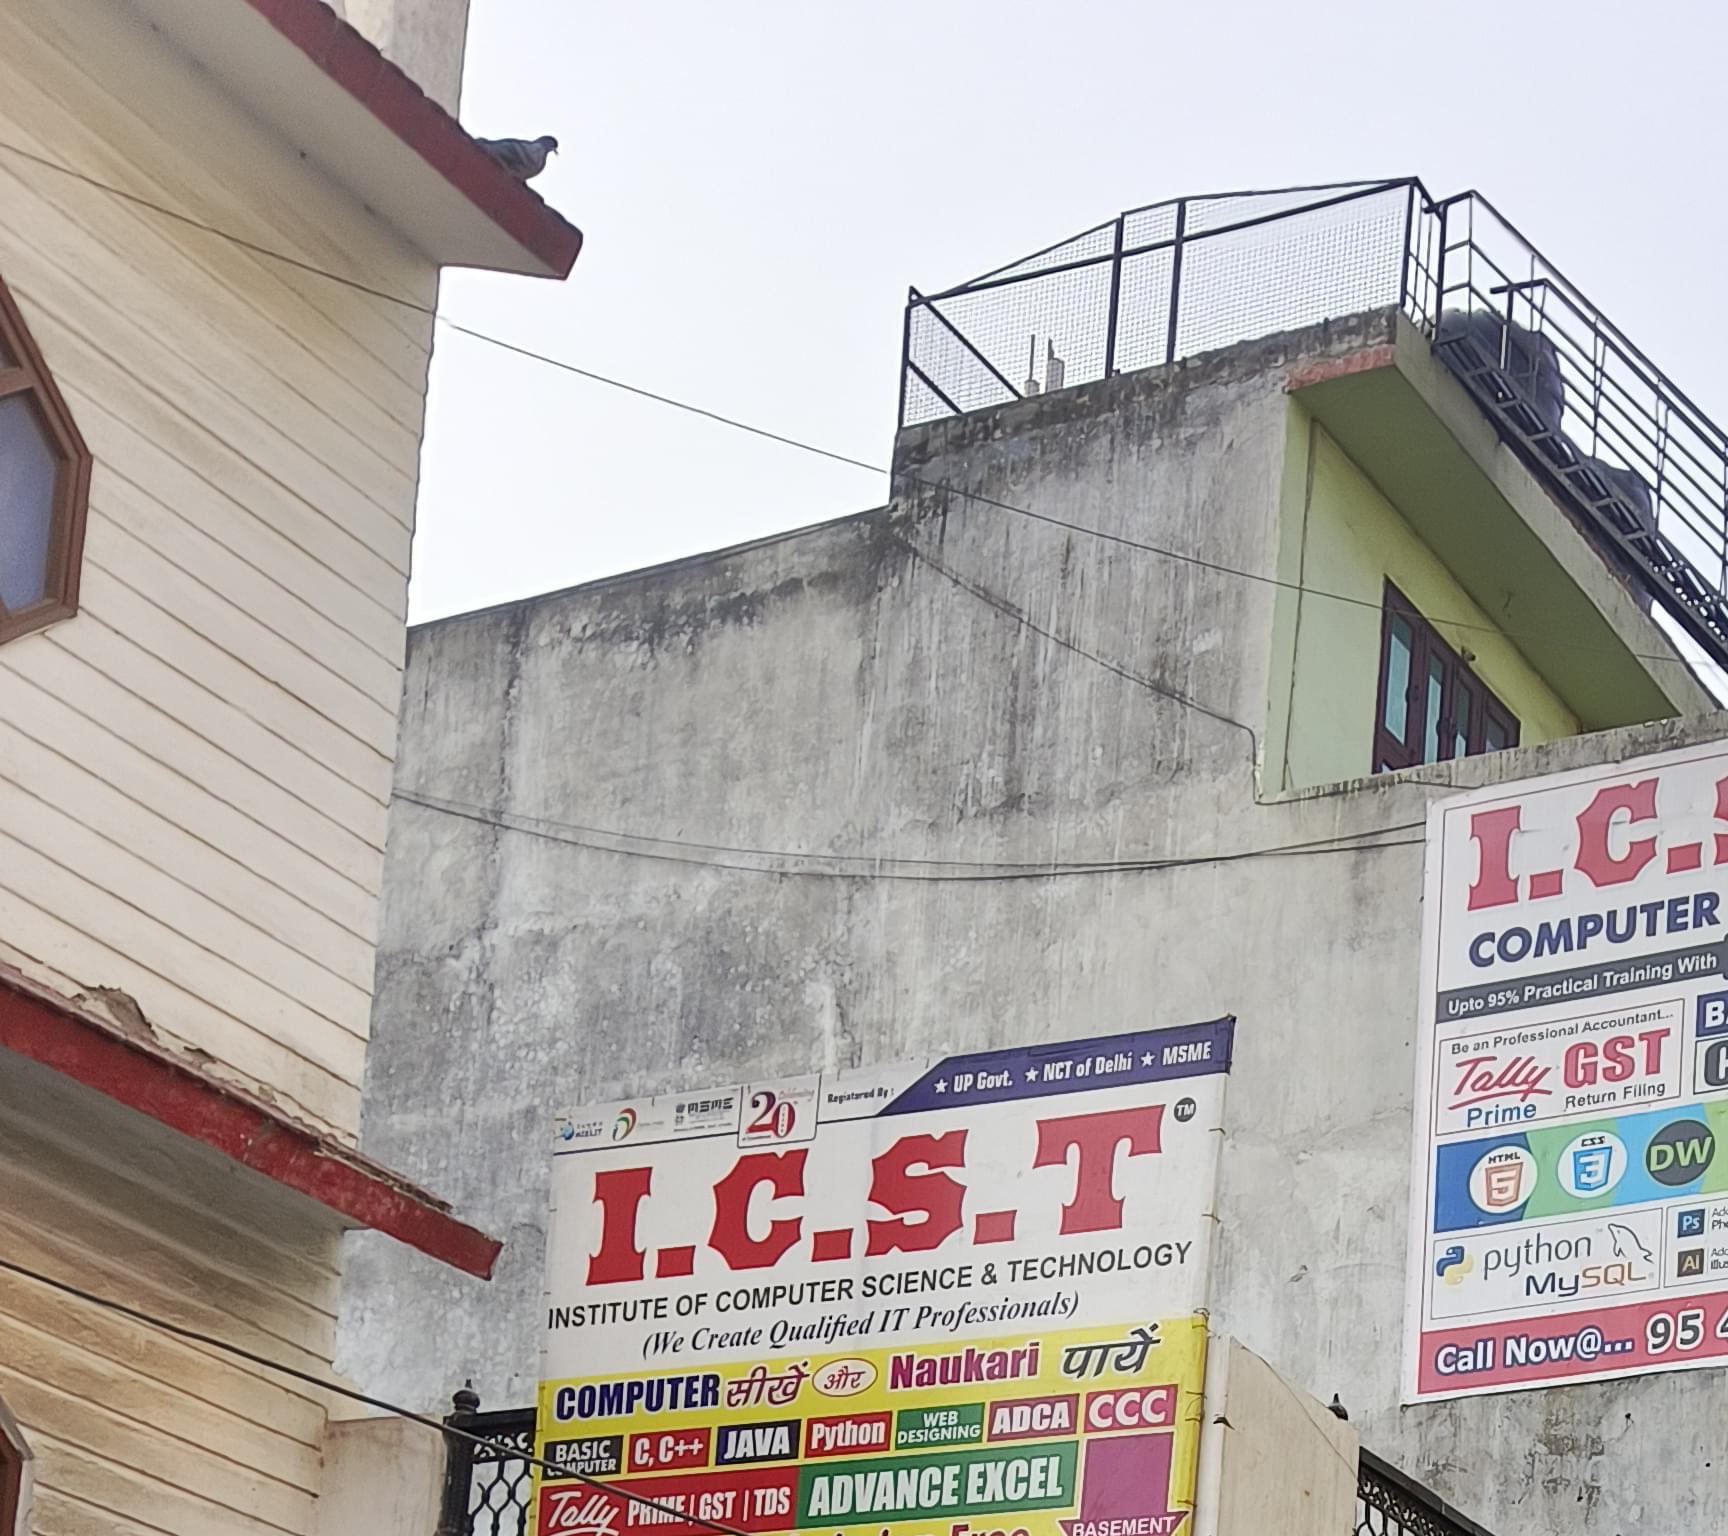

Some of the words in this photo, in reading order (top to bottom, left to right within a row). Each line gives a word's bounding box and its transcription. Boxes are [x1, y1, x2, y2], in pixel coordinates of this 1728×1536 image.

[1468, 892, 1721, 968] COMPUTER
[1448, 993, 1485, 1015] Upto
[1488, 987, 1520, 1009] 95%
[1523, 974, 1598, 1003] Practical
[1603, 960, 1674, 989] Training
[1677, 953, 1718, 974] With
[1451, 1043, 1469, 1055] Be
[1473, 1040, 1489, 1051] an
[1493, 1023, 1579, 1048] Professional
[953, 1073, 973, 1093] UP
[977, 1069, 1013, 1090] Govt.
[1043, 1061, 1073, 1082] NCT
[1076, 1057, 1093, 1077] of
[1095, 1051, 1133, 1075] Delhi
[1162, 1041, 1212, 1066] MSME
[1563, 1027, 1671, 1089] GST
[1449, 1055, 1552, 1107] Tally
[1565, 1090, 1617, 1110] Return
[1622, 1082, 1666, 1099] Filing
[745, 1090, 797, 1138] 20
[1466, 1103, 1537, 1128] Prime
[1487, 1151, 1521, 1164] HTML
[1649, 1136, 1714, 1172] DW
[1682, 1215, 1700, 1231] Ps
[1484, 1233, 1592, 1280] python
[548, 1296, 668, 1329] INSTITUTE
[675, 1293, 708, 1317] OF
[715, 1278, 854, 1312] COMPUTER
[861, 1265, 973, 1298] SCIENCE
[981, 1262, 998, 1286] &
[1006, 1241, 1193, 1283] TECHNOLOGY
[1525, 1261, 1647, 1298] MySQL
[642, 1330, 684, 1360] (We
[691, 1323, 762, 1351] Create
[769, 1310, 875, 1349] Qualified
[878, 1308, 911, 1334] IT
[913, 1290, 1080, 1333] Professionals)
[1437, 1340, 1494, 1374] Call
[1650, 1312, 1701, 1351] 95
[555, 1373, 721, 1420] COMPUTER
[726, 1360, 810, 1408] सीखें
[823, 1364, 867, 1391] और
[889, 1341, 1040, 1390] Naukari
[1062, 1323, 1162, 1379] पायें
[923, 1411, 959, 1428] WEB
[992, 1401, 1071, 1436] ADCA
[1088, 1389, 1167, 1427] CCC
[555, 1439, 611, 1463] BASIC
[659, 1435, 704, 1463] C++
[723, 1426, 790, 1460] JAVA
[811, 1419, 886, 1450] Python
[897, 1424, 981, 1444] DESIGNING
[807, 1466, 961, 1517] ADVANCE
[965, 1455, 1063, 1505] EXCEL
[628, 1496, 686, 1527] PRIME
[699, 1490, 738, 1522] GST
[753, 1486, 791, 1517] TDS
